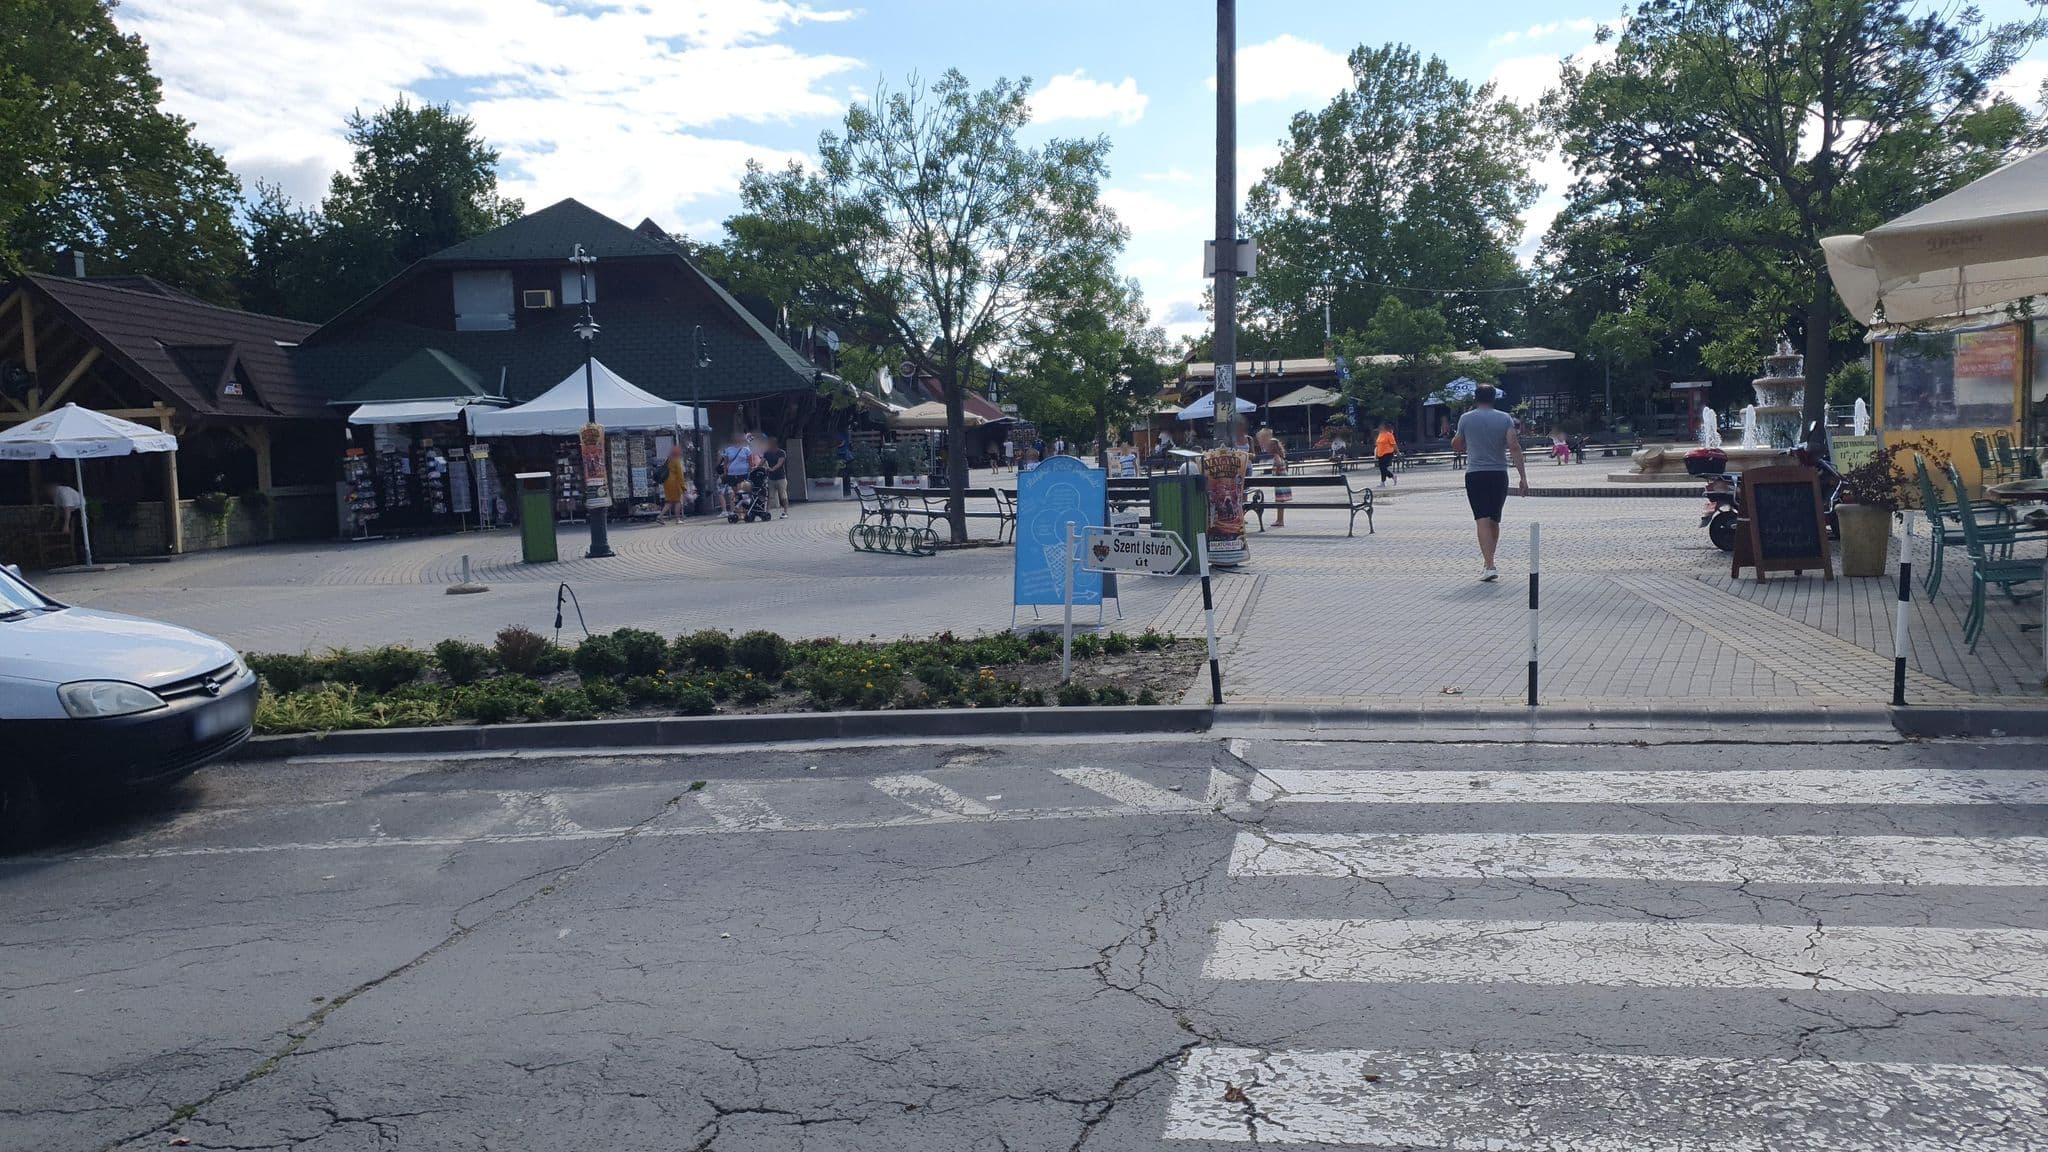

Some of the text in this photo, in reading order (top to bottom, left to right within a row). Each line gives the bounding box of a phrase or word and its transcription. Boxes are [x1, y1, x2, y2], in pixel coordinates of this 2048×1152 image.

[1113, 538, 1172, 556] Szent István
[1135, 557, 1149, 567] út
